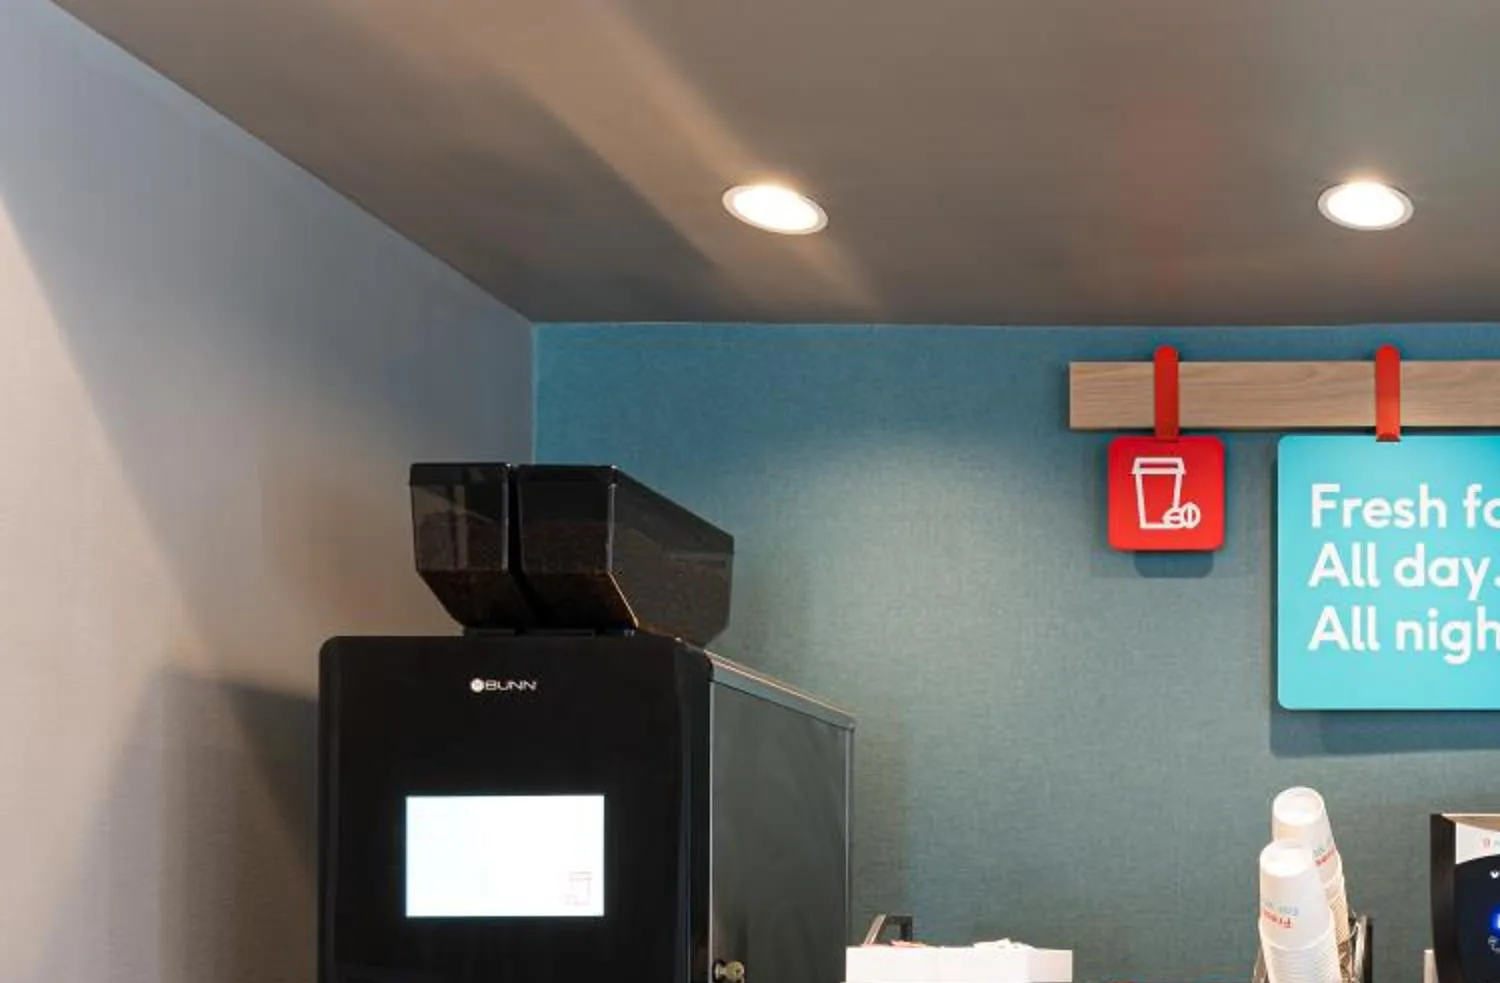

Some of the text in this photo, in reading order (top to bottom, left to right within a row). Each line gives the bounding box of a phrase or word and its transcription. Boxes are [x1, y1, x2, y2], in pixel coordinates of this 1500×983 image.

[1310, 483, 1448, 529] Fresh
[1307, 542, 1381, 589] All
[1307, 604, 1381, 652] All
[485, 679, 537, 691] BUNN
